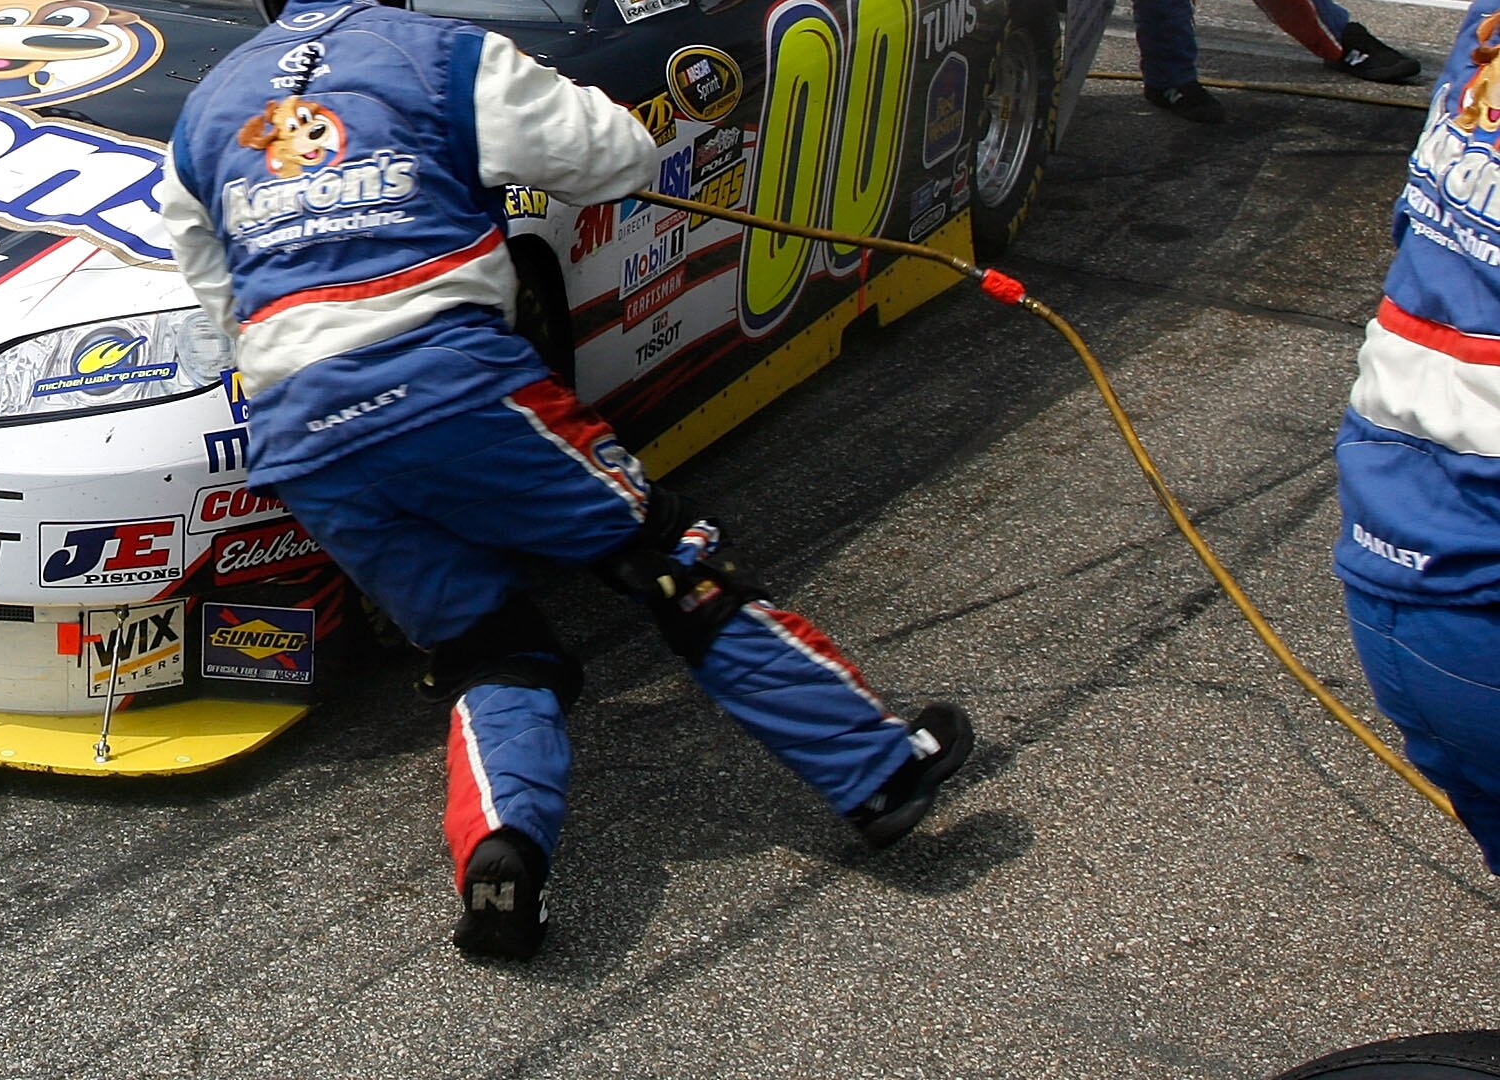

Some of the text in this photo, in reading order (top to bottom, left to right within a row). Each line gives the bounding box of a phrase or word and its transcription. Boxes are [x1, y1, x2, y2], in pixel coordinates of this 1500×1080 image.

[686, 58, 712, 83] NASCAR
[697, 74, 720, 101] Sprint
[701, 151, 733, 176] POLE
[225, 152, 419, 235] Aaron's
[1402, 181, 1440, 222] ream
[304, 210, 414, 237] Machine
[571, 204, 614, 264] 3M
[618, 212, 652, 241] DIRECTV
[624, 236, 667, 288] Mobil
[671, 224, 685, 258] 1
[627, 272, 683, 320] CRAFTSMAN
[636, 320, 682, 365] TISSOT
[37, 367, 170, 391] michael waltrip racing
[308, 383, 408, 433] OAKLEY
[201, 487, 293, 522] COM
[42, 521, 175, 582] JE
[1353, 522, 1434, 571] OAKLEY
[84, 567, 180, 584] PISTONS
[95, 606, 180, 667] WIX
[213, 629, 305, 650] SUNOCO
[94, 654, 180, 693] FLTERS
[206, 664, 309, 681] OFFICIAL FUEL NASCAR
[472, 882, 514, 912] N
